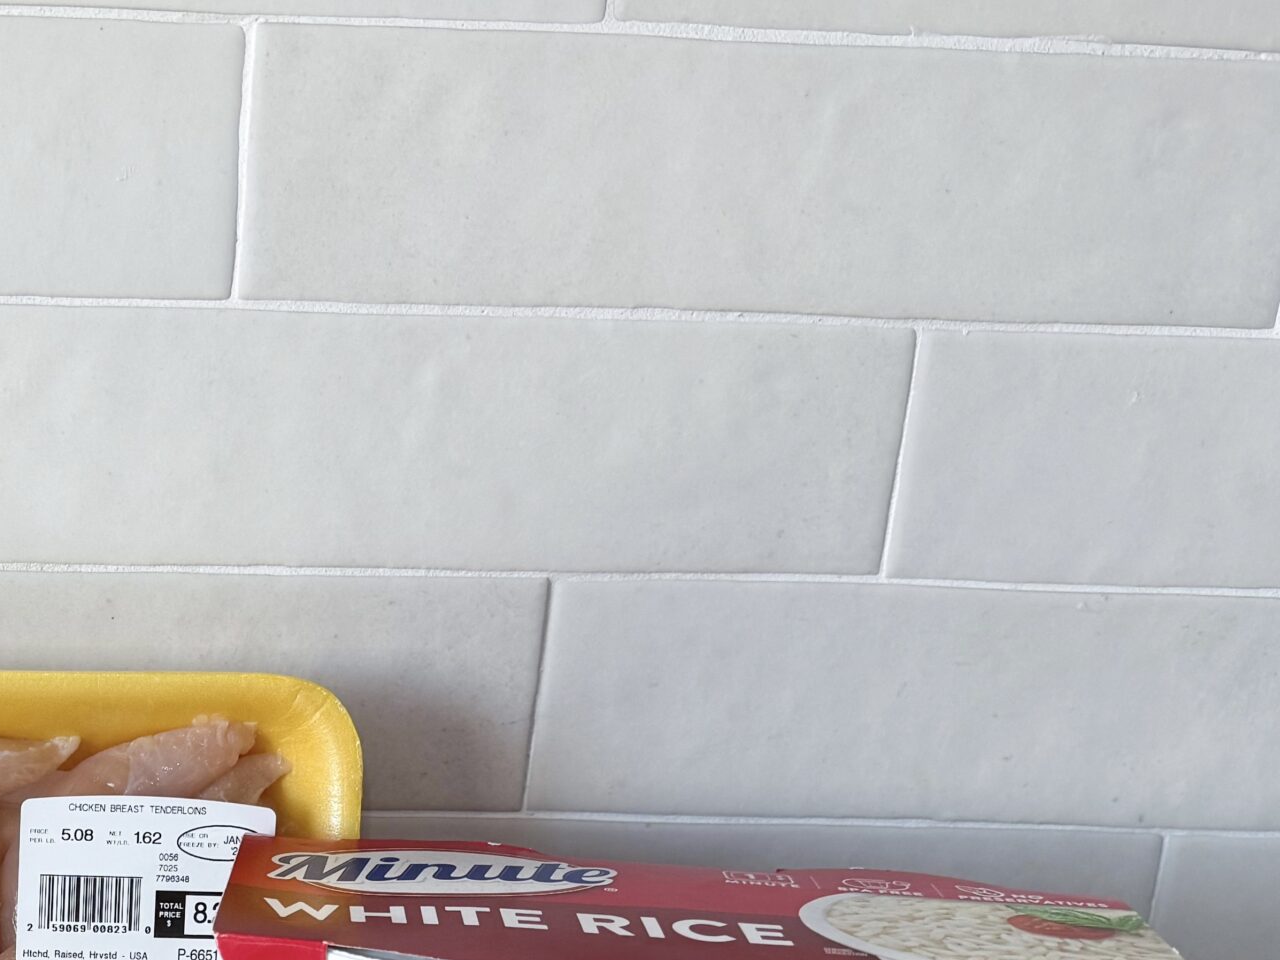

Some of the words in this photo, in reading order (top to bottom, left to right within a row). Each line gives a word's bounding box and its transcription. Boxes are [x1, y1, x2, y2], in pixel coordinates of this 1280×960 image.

[68, 803, 106, 812] CHICKEN
[110, 804, 144, 813] BREAST
[150, 805, 207, 815] TENDERLOINS
[61, 828, 94, 841] 5.08
[159, 853, 178, 861] 0056
[158, 864, 178, 872] 7025
[271, 850, 616, 892] Minute
[159, 902, 183, 910] TOTAL
[958, 895, 1109, 909] PRESERVATIVES
[264, 898, 549, 931] WHITE
[576, 912, 795, 947] RICE
[27, 923, 33, 932] 2
[52, 924, 86, 933] 59069
[93, 925, 127, 934] 00823
[144, 926, 151, 934] 0
[22, 949, 50, 959] Htchd,
[54, 950, 85, 960] Raised,
[89, 951, 117, 960] Hrvstd
[129, 952, 148, 960] USA
